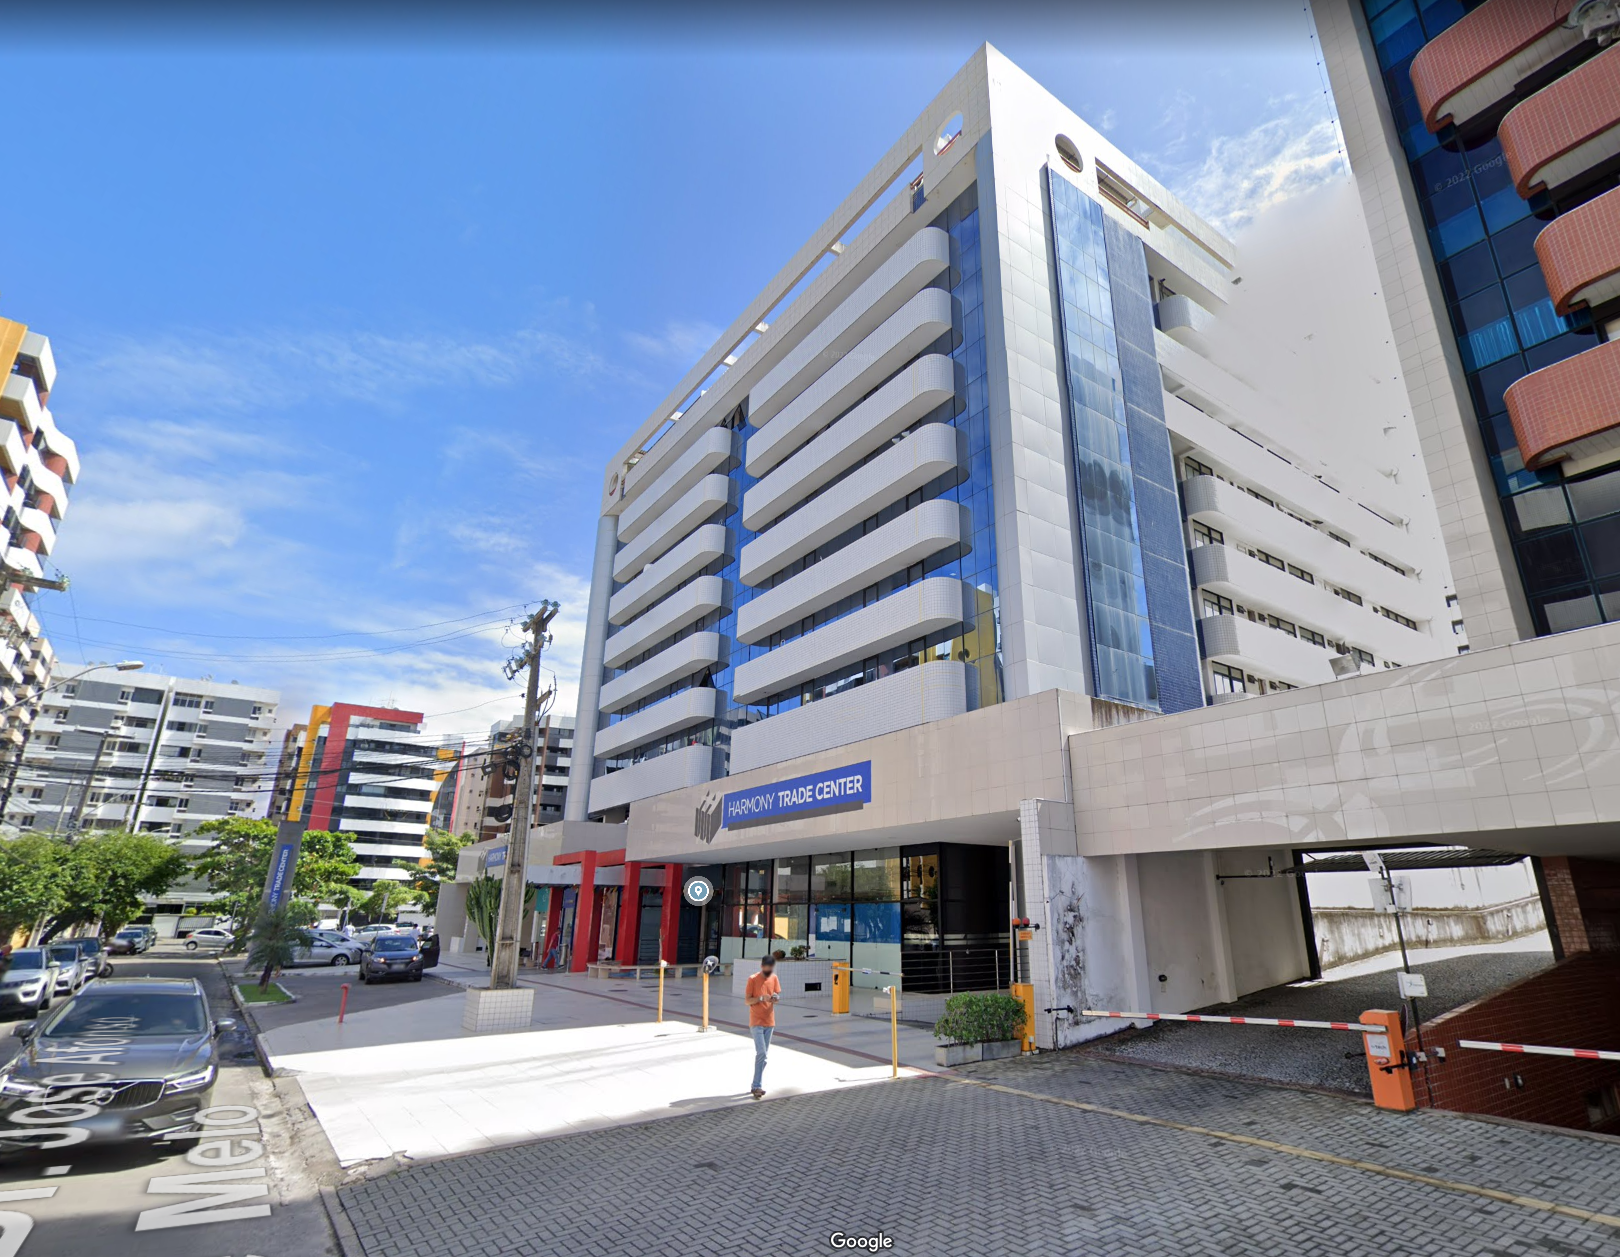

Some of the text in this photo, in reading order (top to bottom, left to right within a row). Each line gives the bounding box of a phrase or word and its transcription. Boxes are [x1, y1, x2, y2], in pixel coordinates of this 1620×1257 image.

[728, 774, 863, 817] HARMONY TRADE CENTER
[278, 849, 289, 871] CENTER
[273, 871, 284, 891] TRADE
